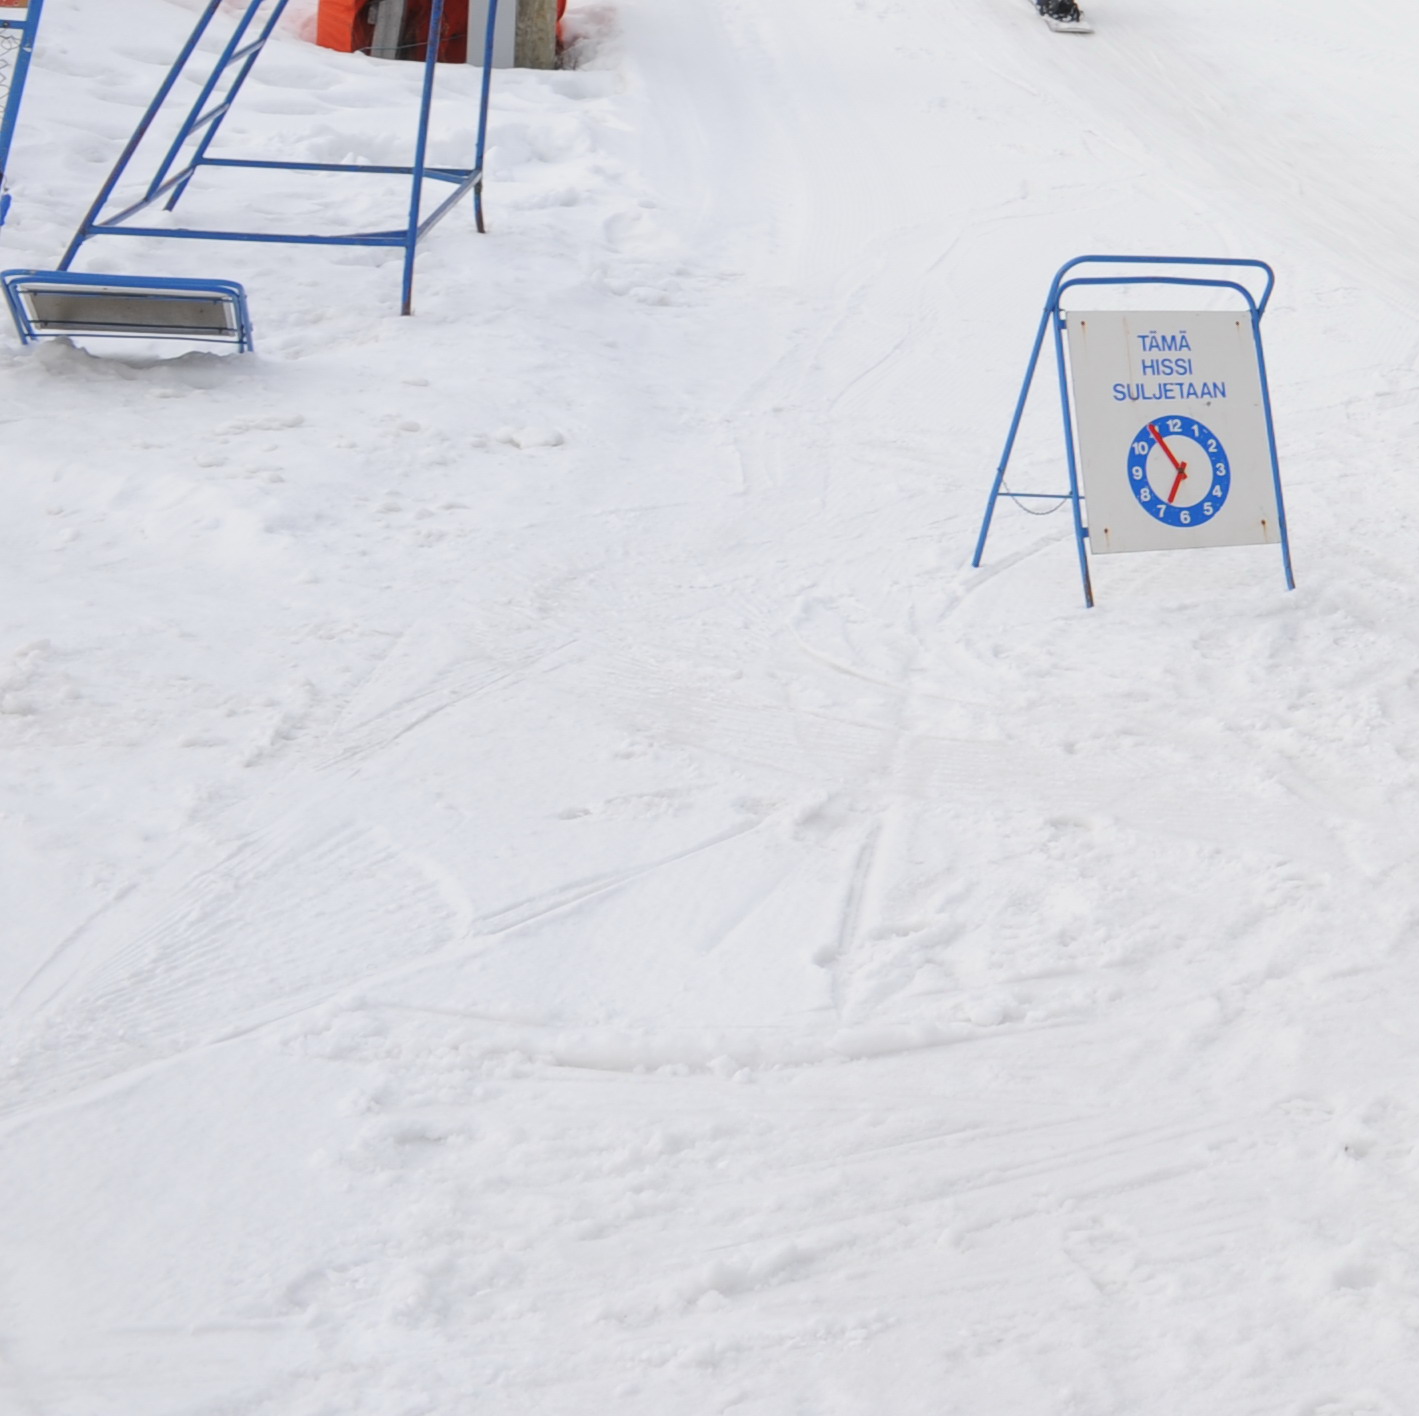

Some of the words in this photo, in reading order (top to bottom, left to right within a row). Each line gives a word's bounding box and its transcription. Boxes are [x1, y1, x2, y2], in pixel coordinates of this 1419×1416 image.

[1137, 330, 1192, 353] TÄMÄ
[1141, 358, 1194, 377] HISSI
[1112, 382, 1227, 402] SULJETAAN
[1166, 419, 1182, 433] 12
[1191, 424, 1199, 438] 1
[1132, 441, 1149, 456] 10
[1207, 438, 1218, 453] 2
[1131, 466, 1143, 481] 9
[1215, 462, 1226, 477] 3
[1139, 487, 1151, 502] 8
[1211, 484, 1222, 498] 4
[1156, 504, 1167, 519] 7
[1203, 501, 1214, 516] 5
[1179, 510, 1191, 524] 6
